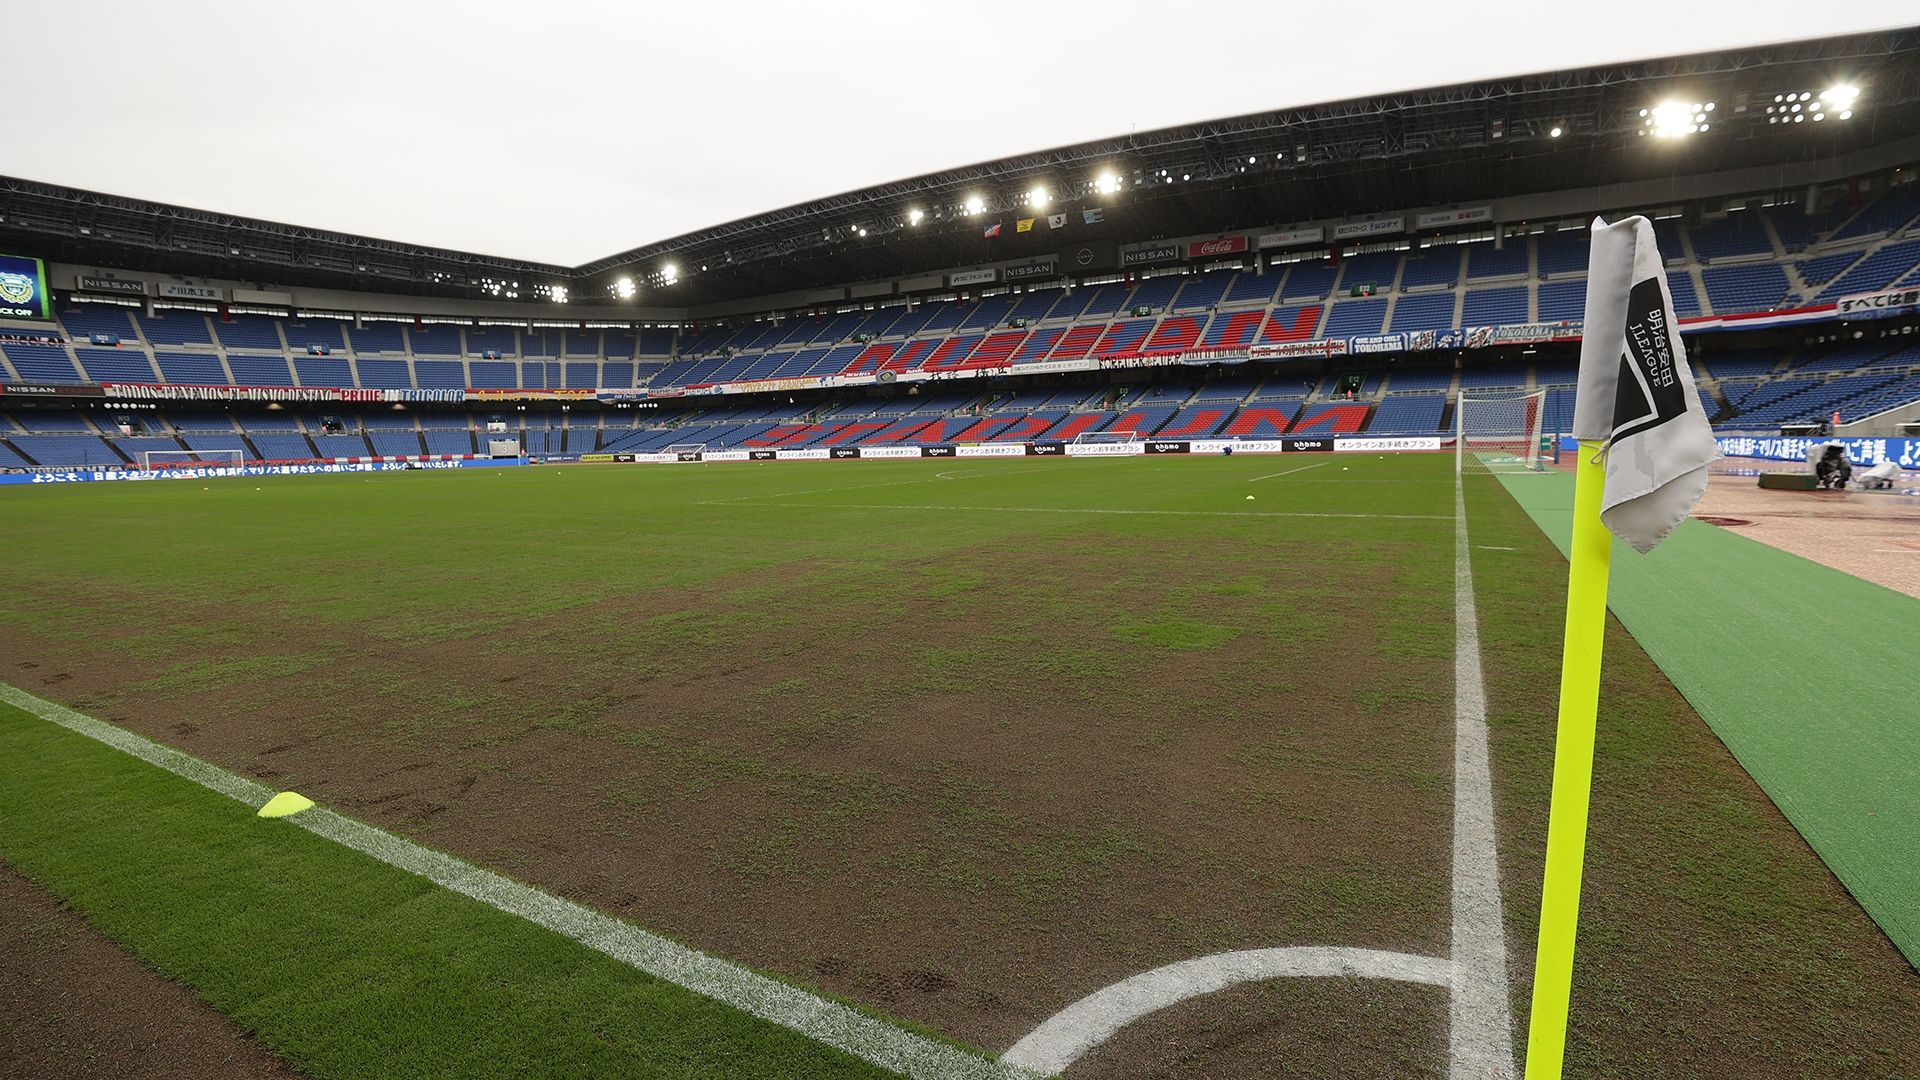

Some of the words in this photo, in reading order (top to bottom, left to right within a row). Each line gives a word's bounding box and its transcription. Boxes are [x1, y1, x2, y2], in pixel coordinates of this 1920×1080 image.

[1201, 240, 1234, 254] Coca-Cola
[1126, 250, 1174, 262] NISSAN
[1007, 265, 1049, 276] NISSAN
[84, 279, 142, 291] NISSAN
[1355, 342, 1403, 353] YOKOHAMA
[1647, 308, 1674, 388] 明治安田
[1629, 323, 1661, 387] J.LEAGUE
[112, 384, 158, 399] TODOS
[161, 385, 225, 400] TENEMOS
[228, 386, 242, 400] EL
[247, 387, 285, 400] MISMO
[288, 387, 333, 400] DESTINO
[341, 388, 381, 401] PRIDE
[384, 389, 400, 401] IN
[401, 389, 466, 402] TRICOLOR
[502, 443, 508, 453] 3
[1155, 443, 1180, 452] ahamo
[1293, 441, 1322, 450] ahamo
[1339, 439, 1435, 449] オンラインお手続きプラン
[929, 448, 948, 456] ahamo
[959, 447, 1022, 455] オンラインお手続きプラン
[1034, 446, 1056, 454] ahamo
